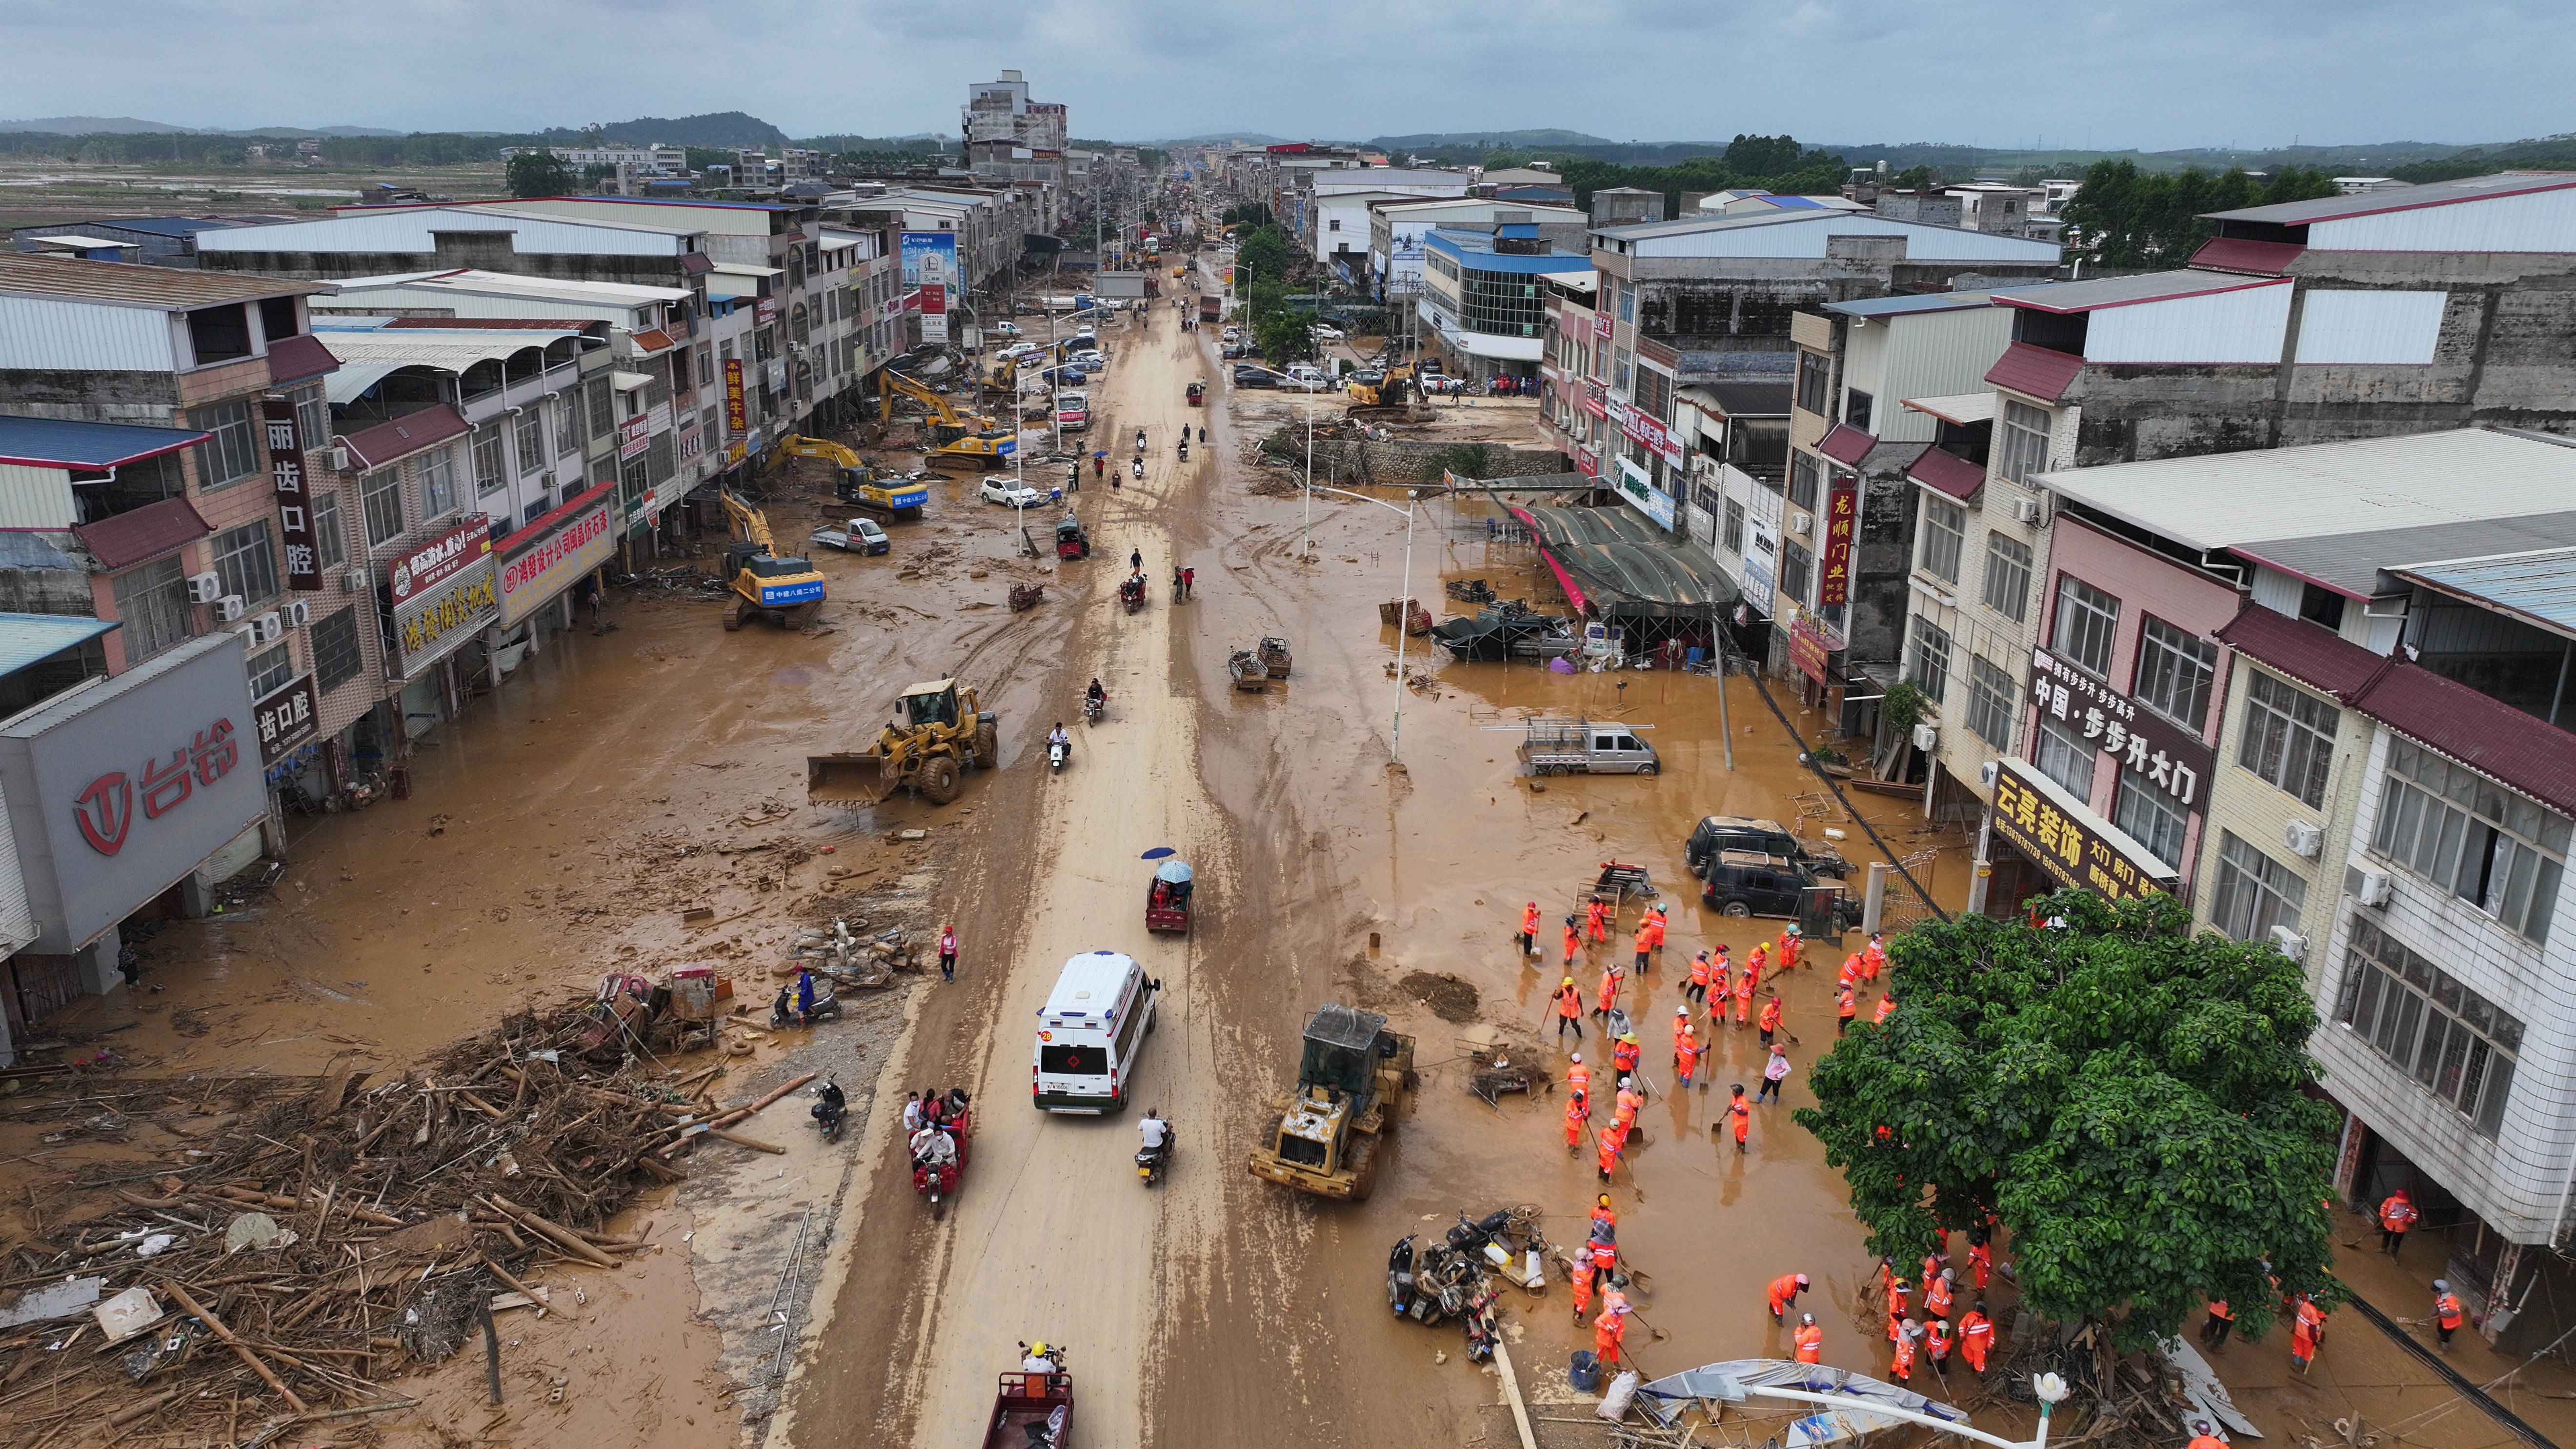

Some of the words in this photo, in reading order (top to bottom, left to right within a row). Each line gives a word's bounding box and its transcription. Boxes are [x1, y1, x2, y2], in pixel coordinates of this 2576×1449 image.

[727, 371, 744, 429] 鲜美牛杂
[265, 418, 315, 575] 丽齿口腔
[1828, 495, 1851, 579] 龙顺门业
[776, 586, 821, 598] 中建八局二公司
[255, 691, 310, 743] 齿口腔
[2053, 661, 2095, 698] 拥有步步升
[2098, 688, 2135, 722] 步步高升
[140, 718, 238, 820] 台铃
[1998, 774, 2083, 868] 云亮装饰
[2089, 863, 2119, 899] 断桥窗
[2090, 840, 2110, 866] 大门
[2113, 857, 2134, 886] 房门
